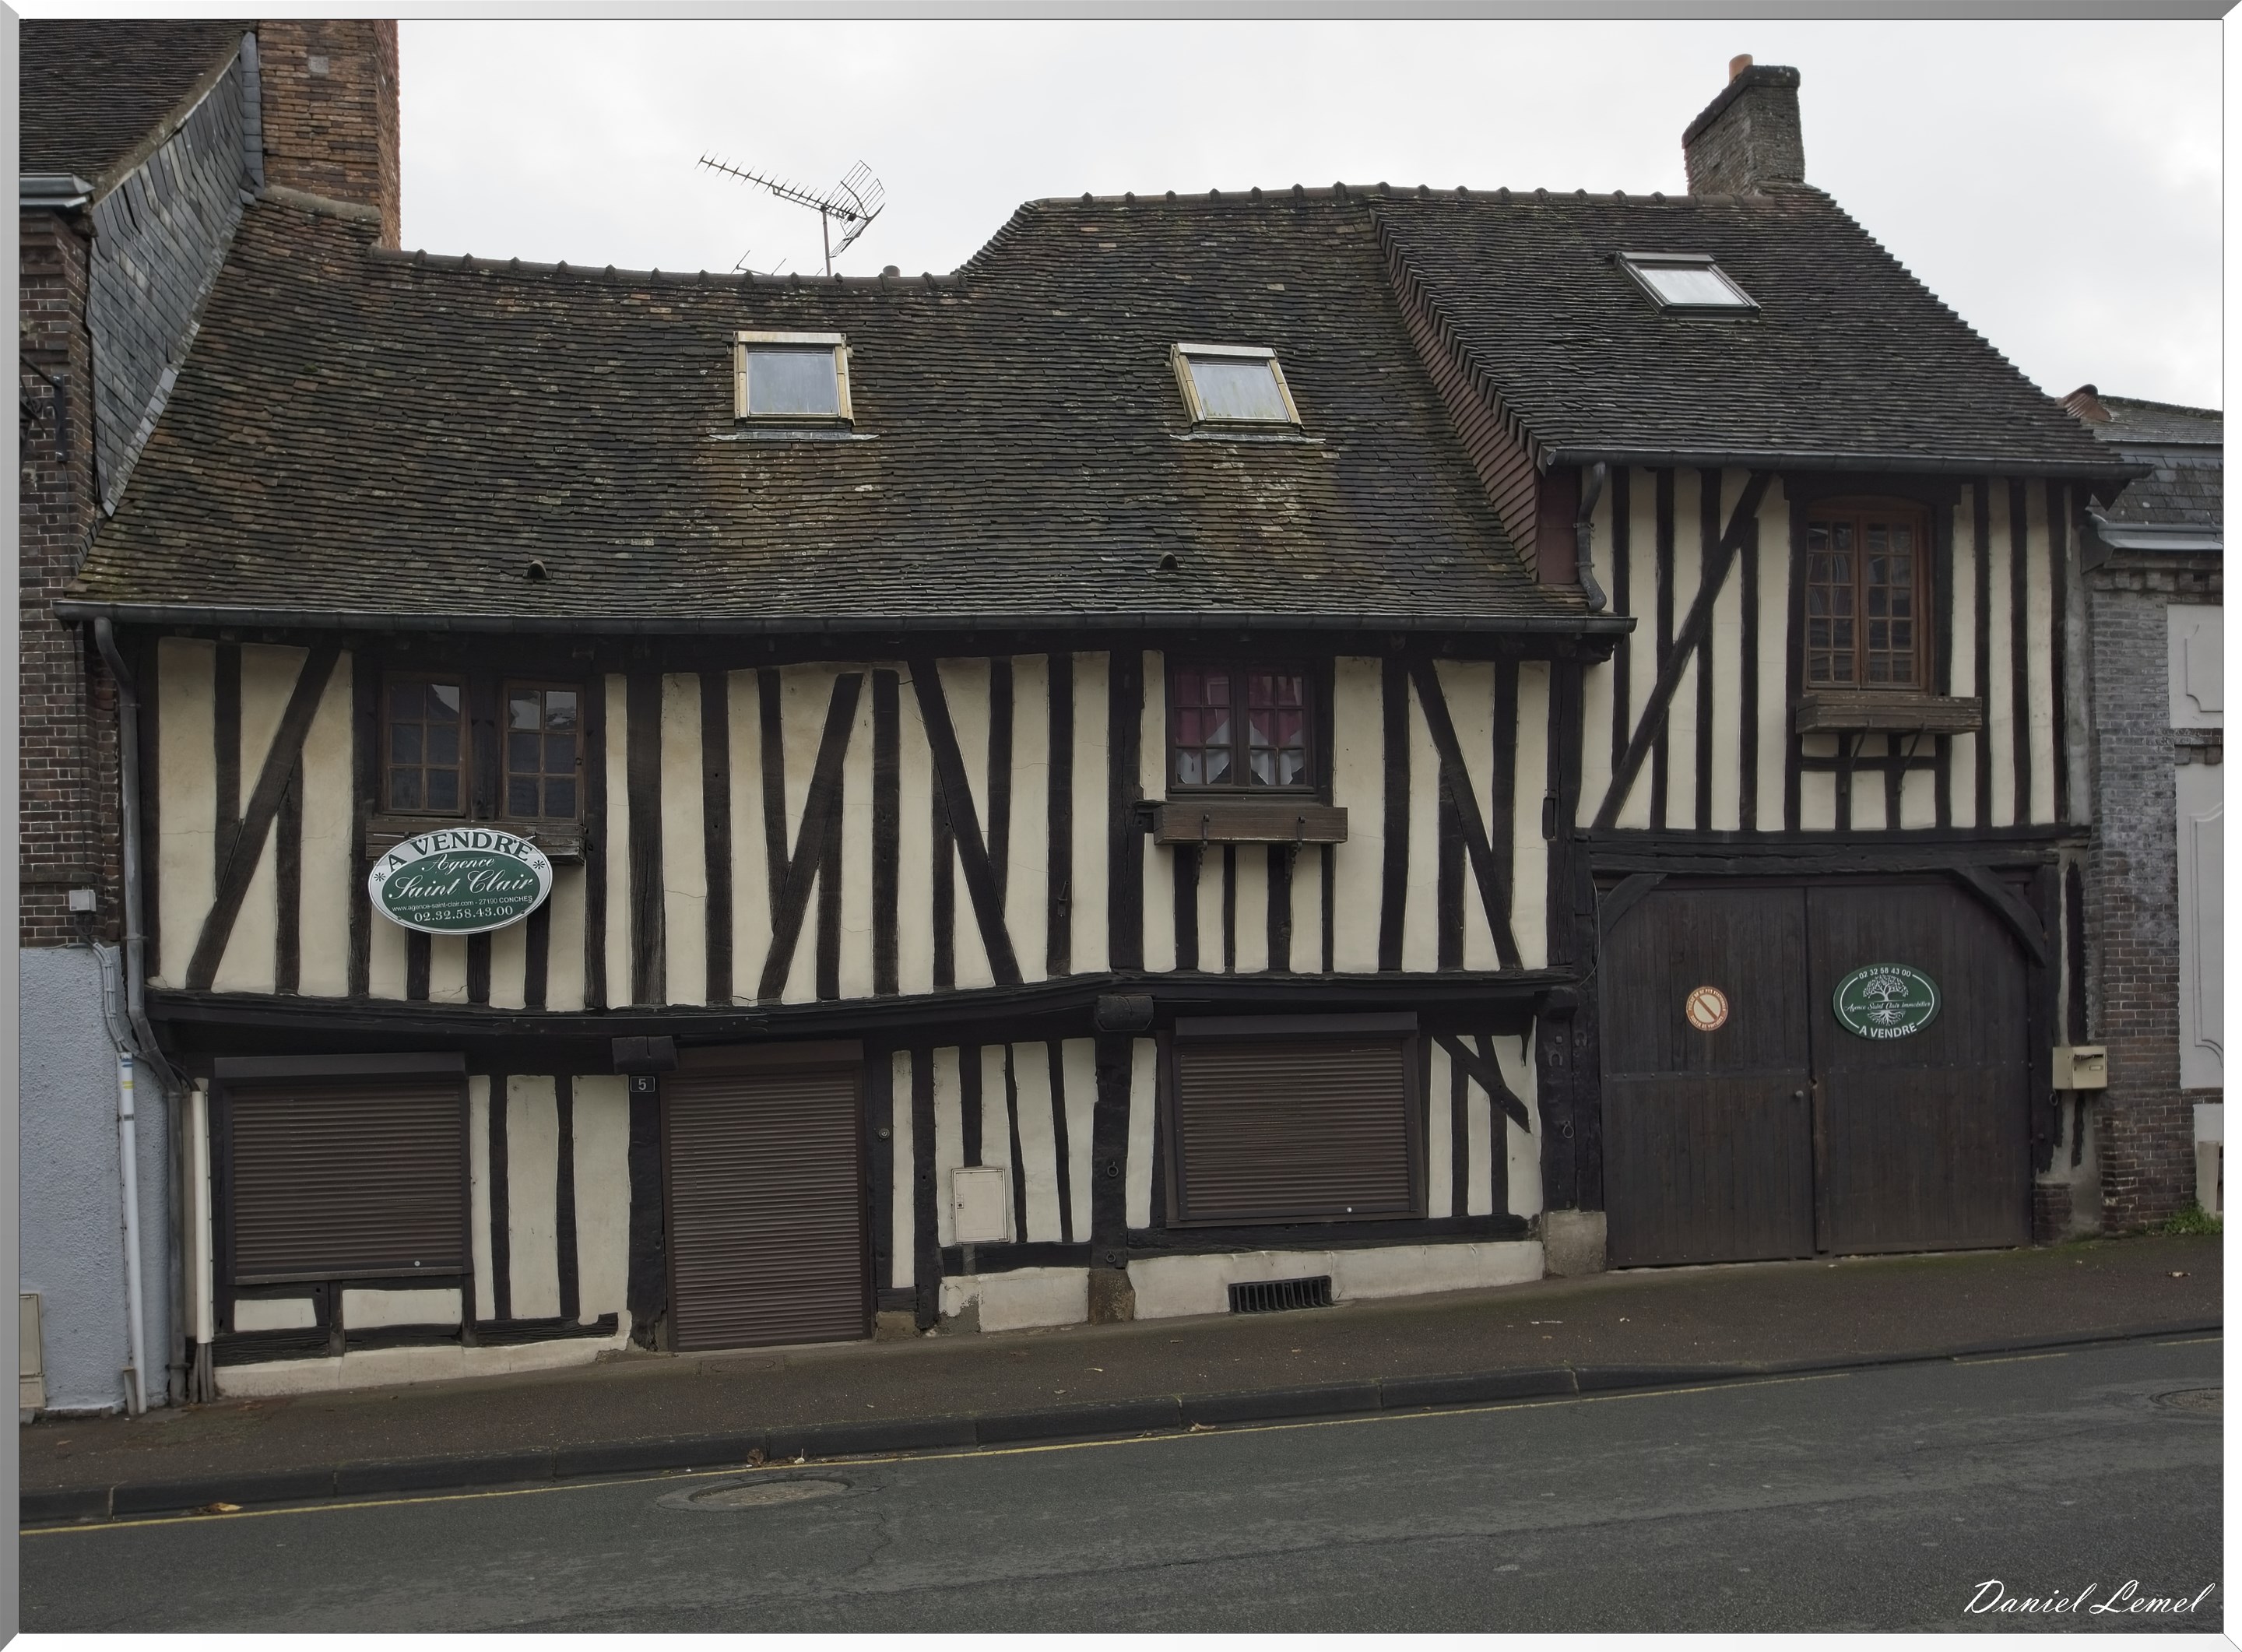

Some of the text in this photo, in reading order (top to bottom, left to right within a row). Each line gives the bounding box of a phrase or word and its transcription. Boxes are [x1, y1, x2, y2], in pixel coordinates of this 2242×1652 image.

[387, 831, 533, 873] A VENDRE
[421, 853, 495, 875] Agence
[388, 870, 533, 900] Saint Clair
[392, 900, 474, 912] www.agence-saint-clair.com
[499, 895, 533, 904] CONCHES
[414, 905, 513, 923] 02.32.58.43.00
[1858, 971, 1868, 979] 02
[1870, 968, 1878, 976] 32
[1859, 1022, 1917, 1039] A VENDRE
[638, 1078, 647, 1091] 5
